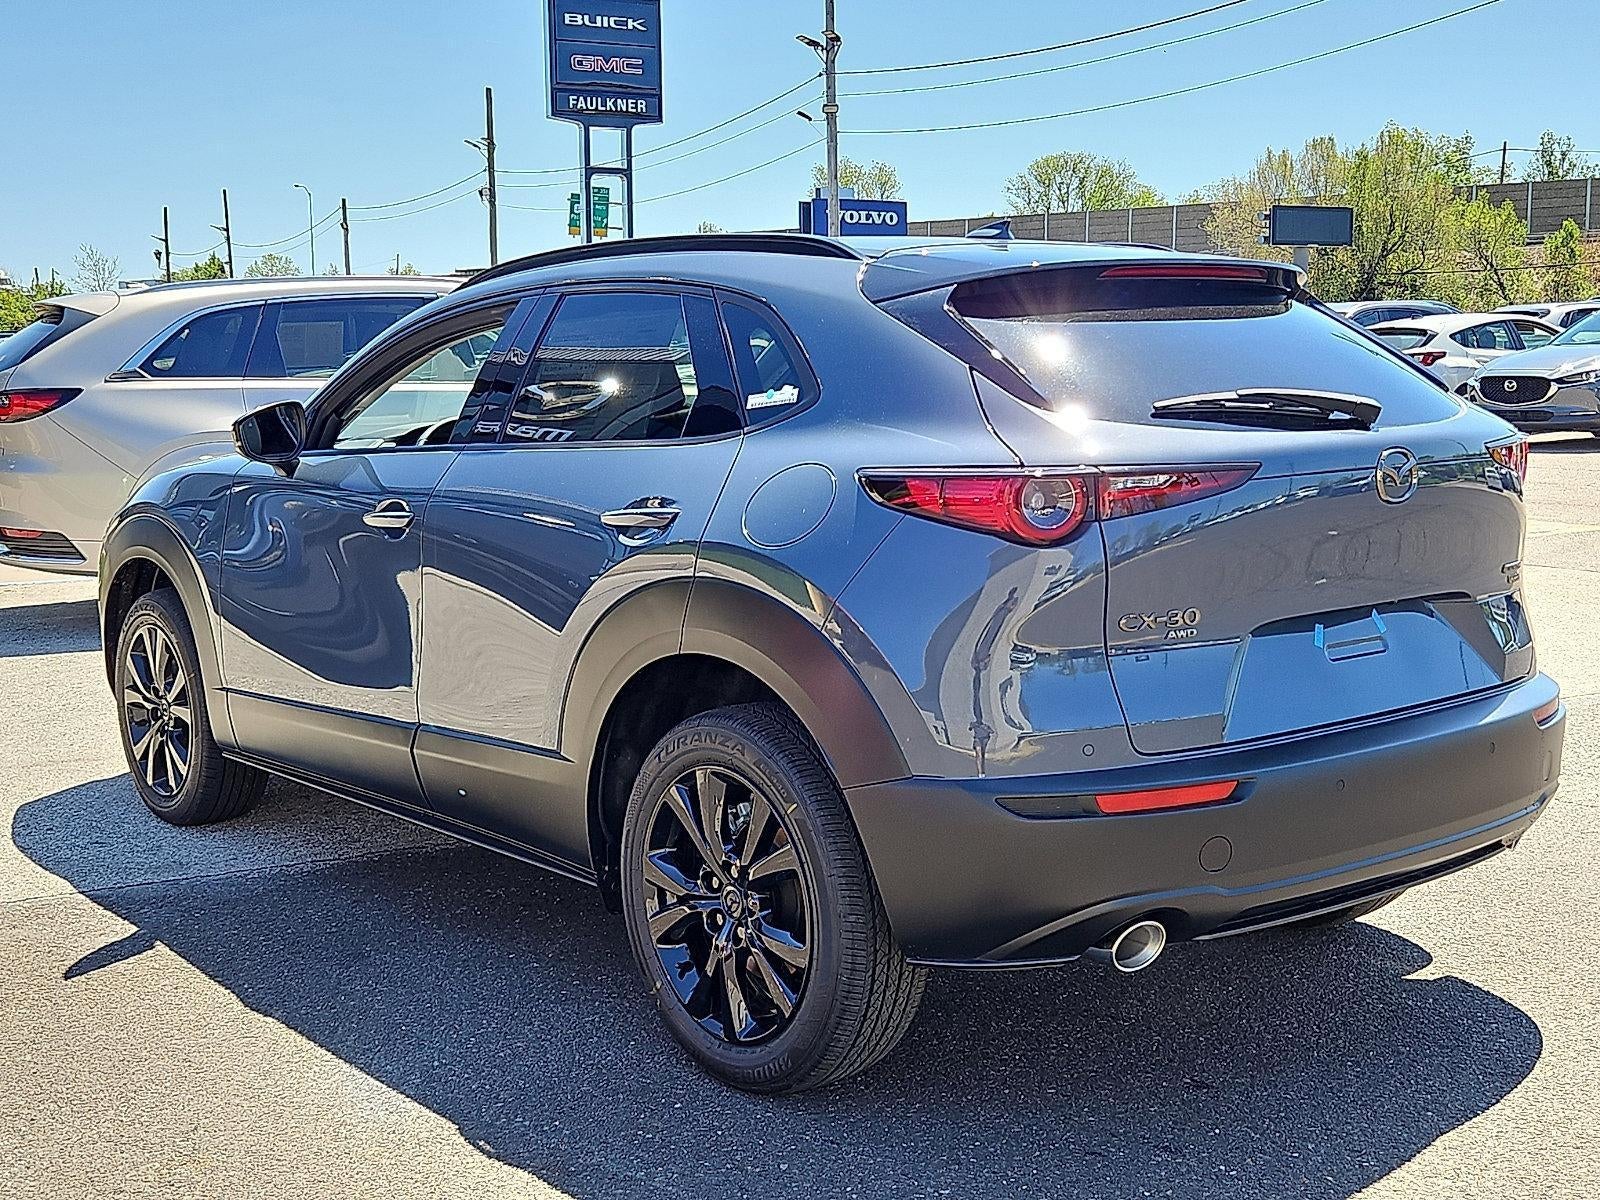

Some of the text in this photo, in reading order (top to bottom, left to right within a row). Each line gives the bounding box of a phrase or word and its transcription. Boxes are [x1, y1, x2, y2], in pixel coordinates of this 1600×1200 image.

[564, 13, 647, 31] BUICK
[571, 54, 643, 74] GMC
[569, 96, 647, 112] FAULKNER
[1118, 607, 1201, 632] CX-30
[1164, 628, 1198, 640] AWD
[654, 731, 747, 764] TURANZA
